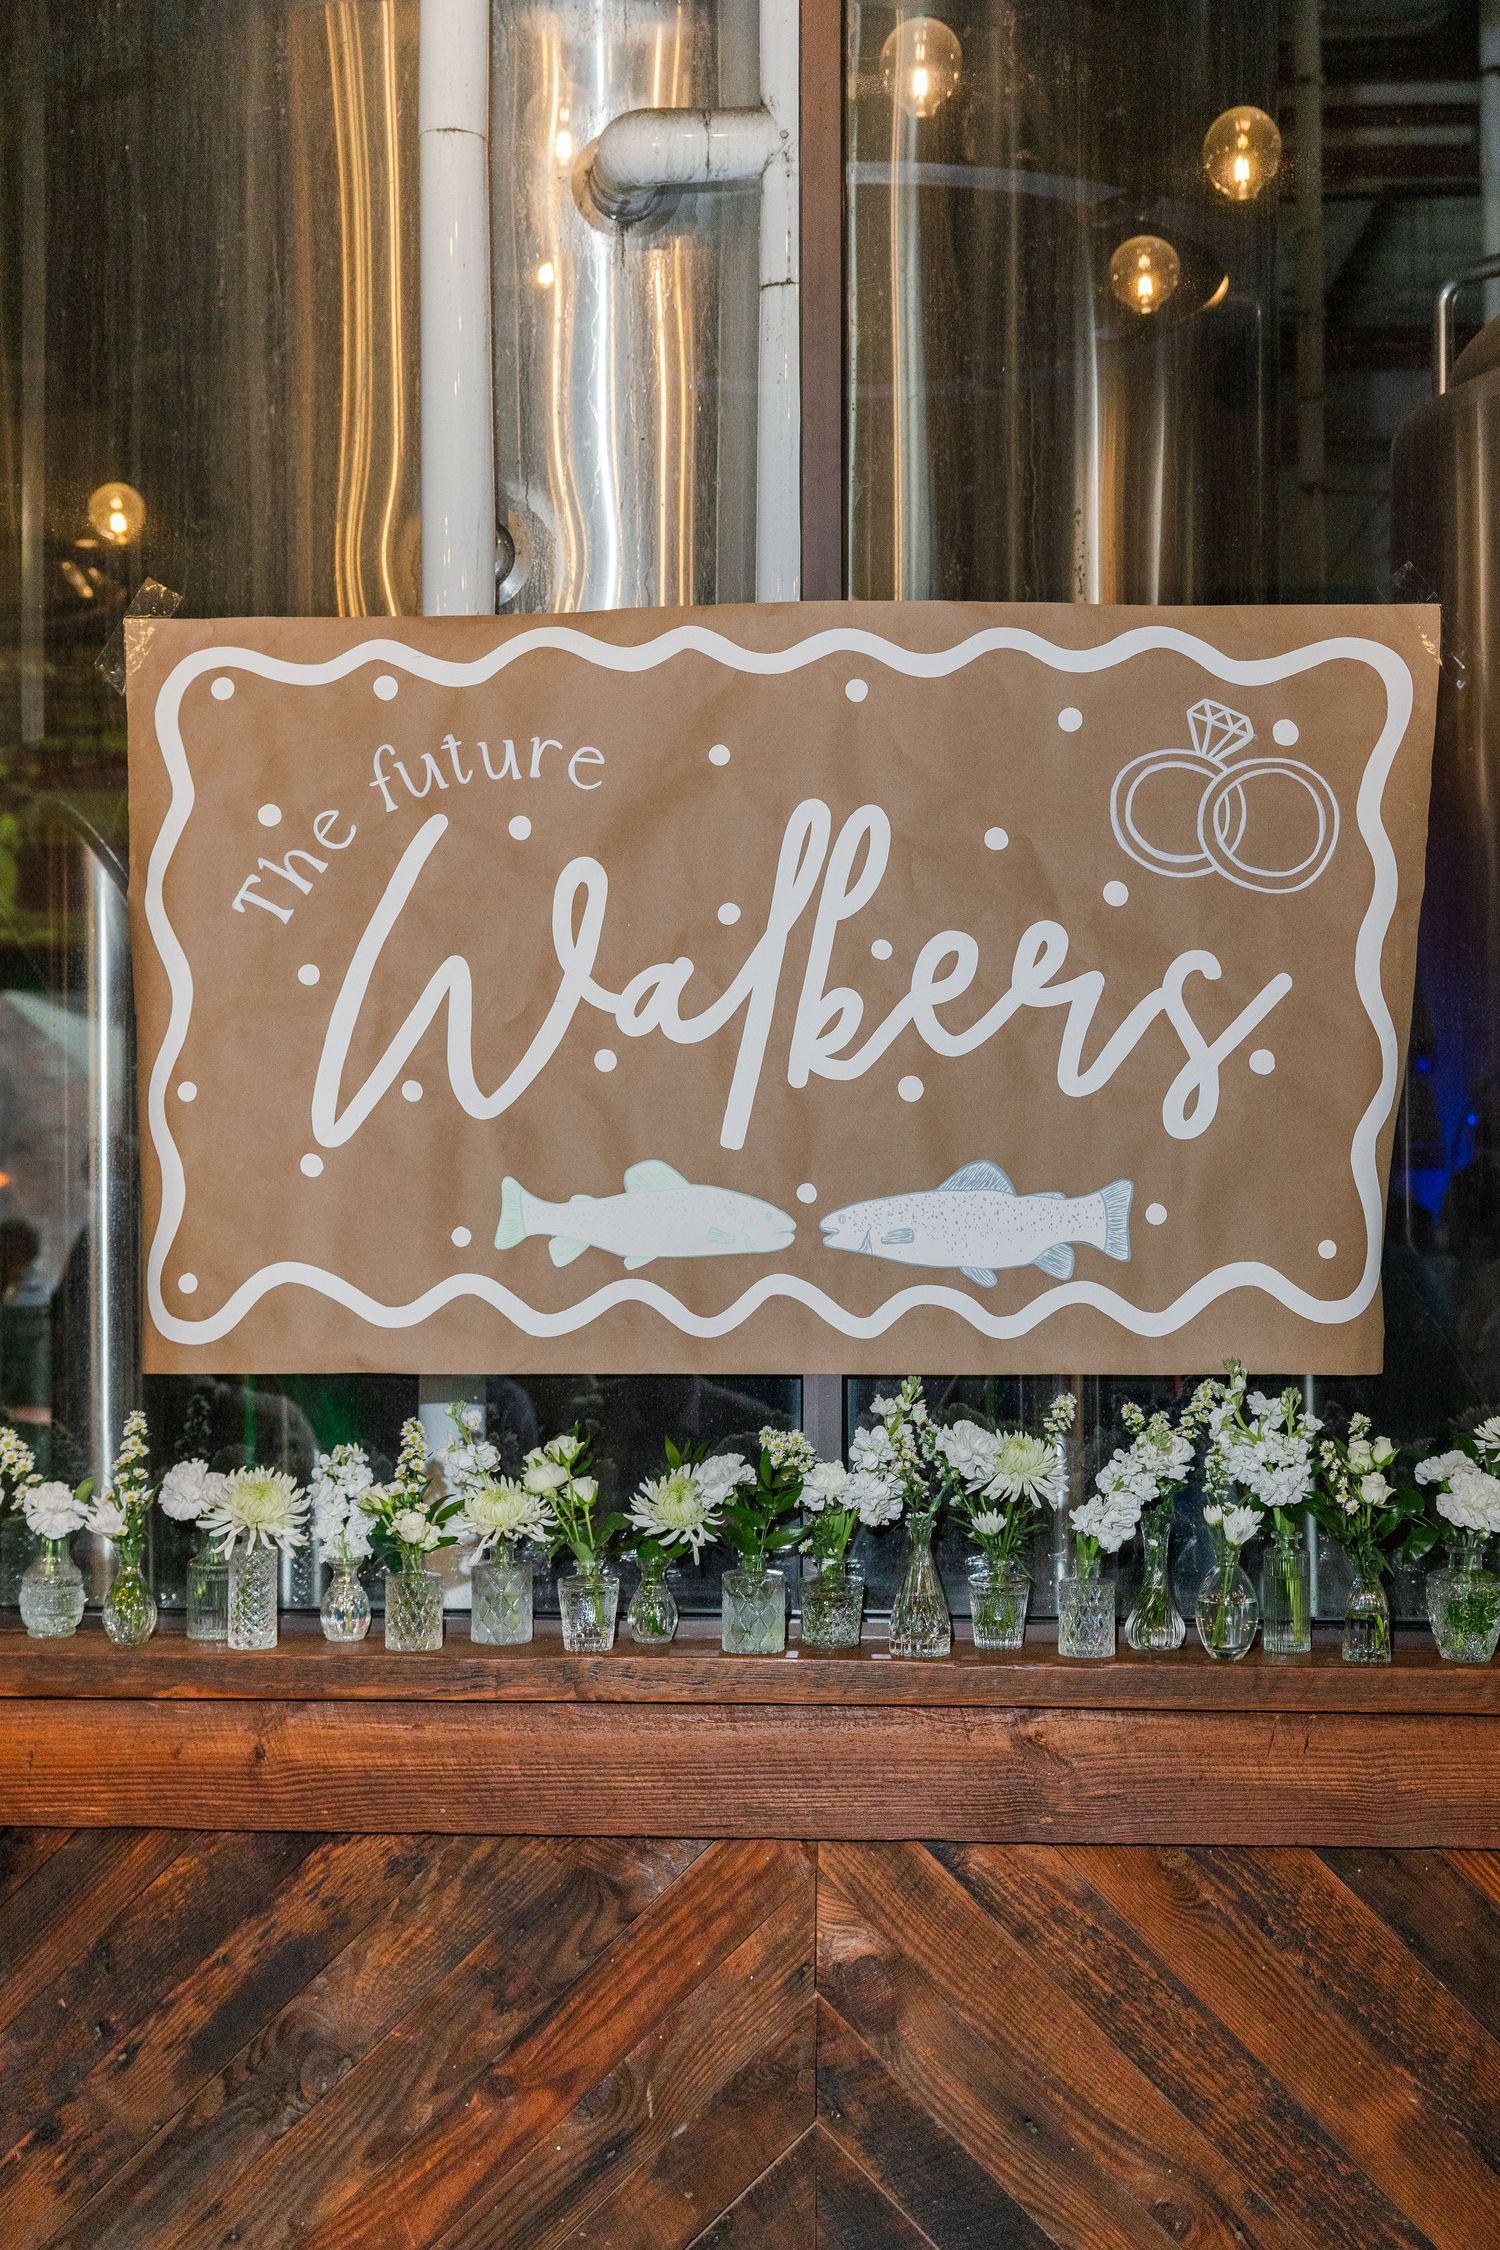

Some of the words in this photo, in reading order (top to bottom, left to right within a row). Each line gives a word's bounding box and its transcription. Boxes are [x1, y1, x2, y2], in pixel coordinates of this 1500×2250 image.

[231, 809, 357, 925] The
[369, 733, 605, 812] future
[311, 798, 1294, 1151] Walkers
